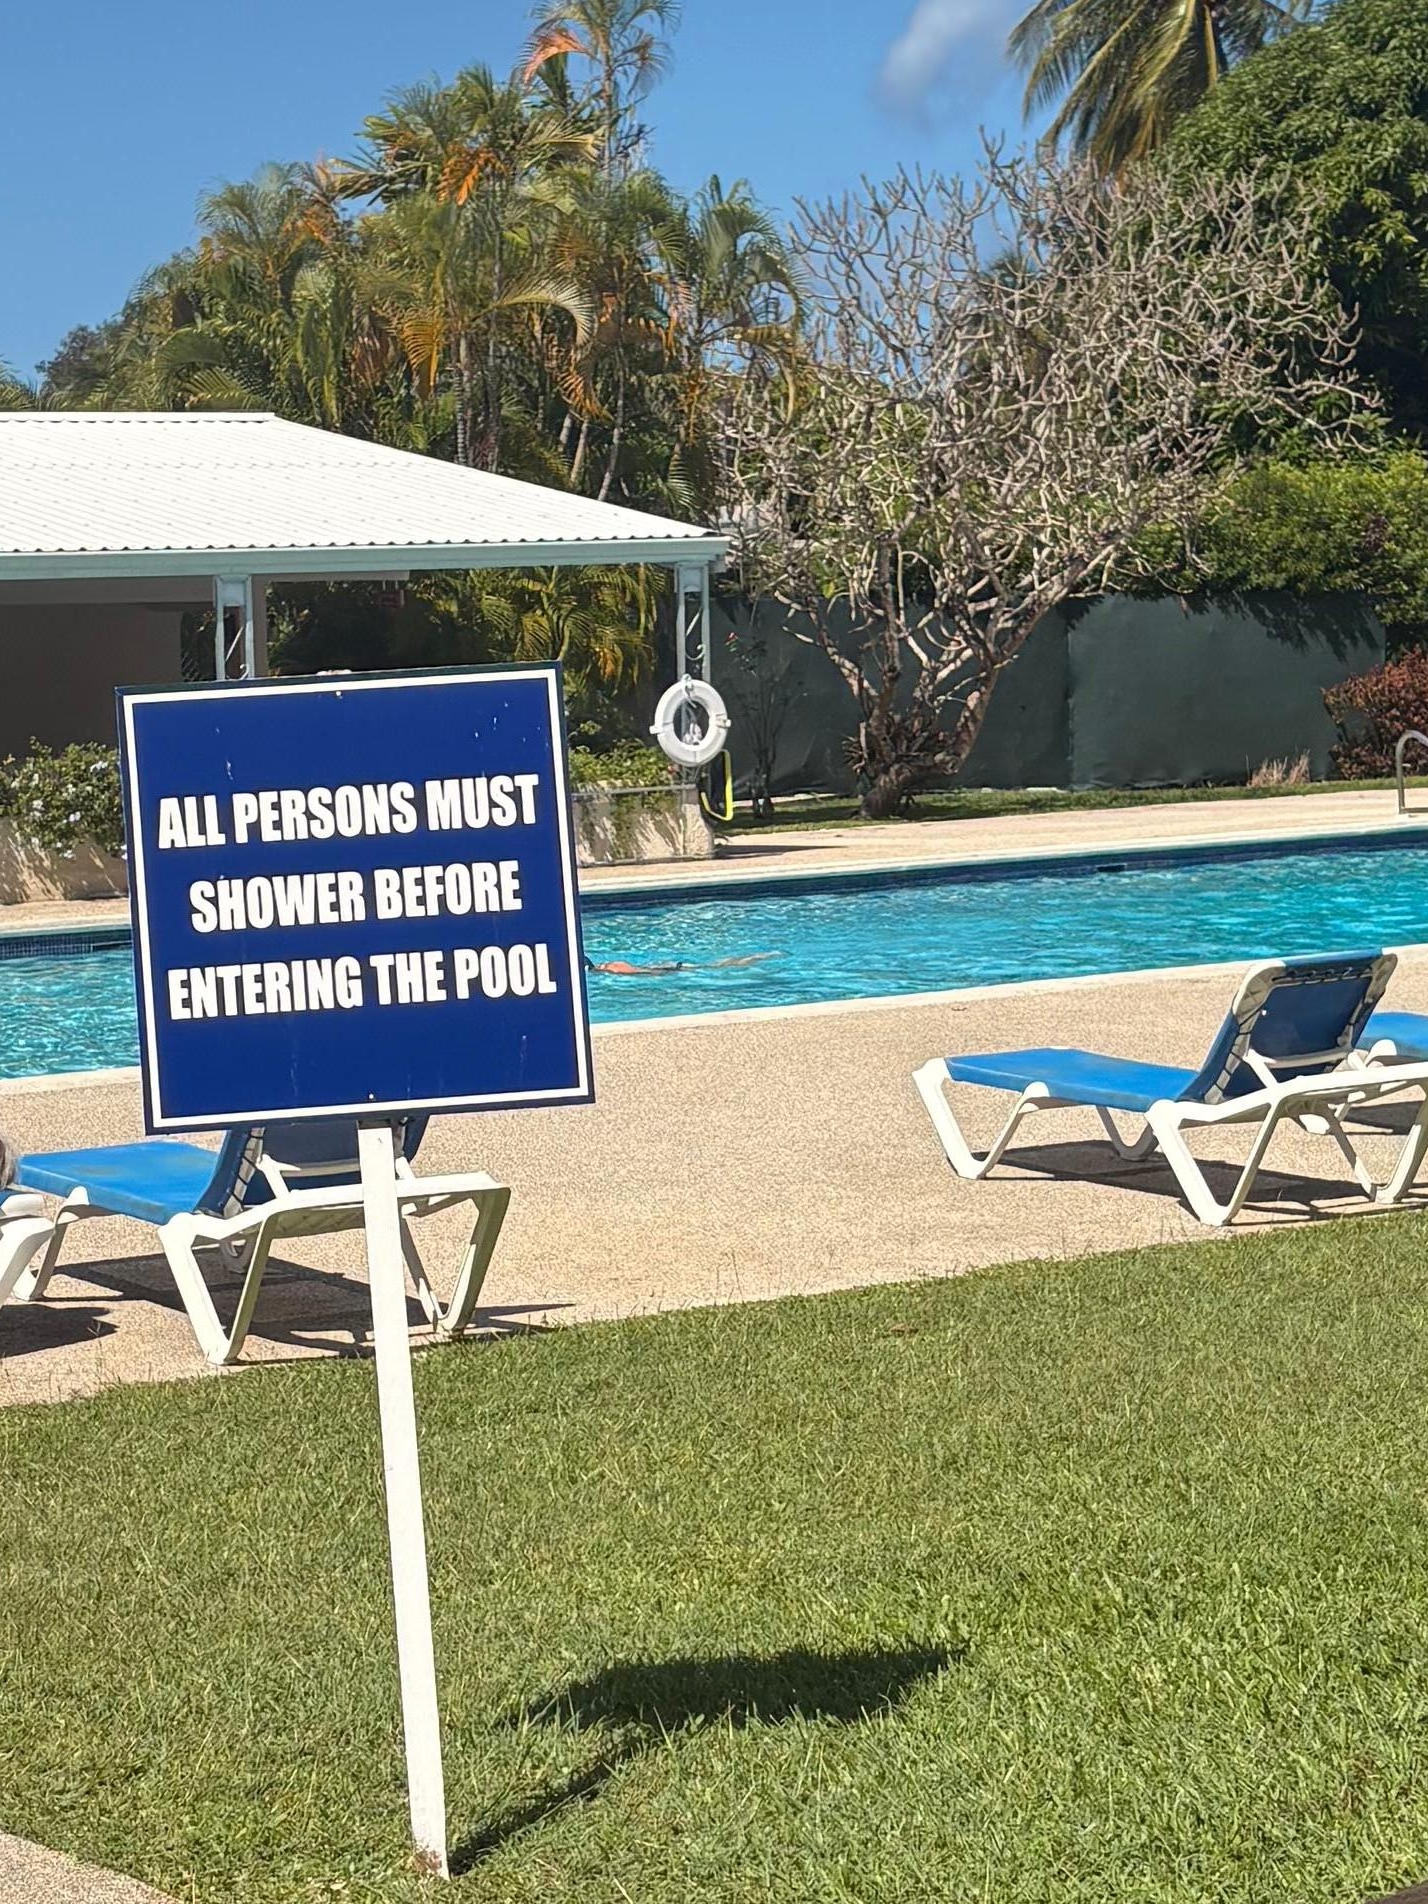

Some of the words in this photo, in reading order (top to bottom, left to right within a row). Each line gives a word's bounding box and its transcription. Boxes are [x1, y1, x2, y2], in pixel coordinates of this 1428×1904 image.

[159, 795, 225, 848] ALL
[233, 782, 417, 843] PERSONS
[426, 774, 538, 830] MUST
[190, 872, 365, 932] SHOWER
[374, 861, 522, 919] BEFORE
[168, 956, 363, 1020] ENTERING
[370, 951, 446, 1004] THE
[454, 944, 556, 999] POOL
